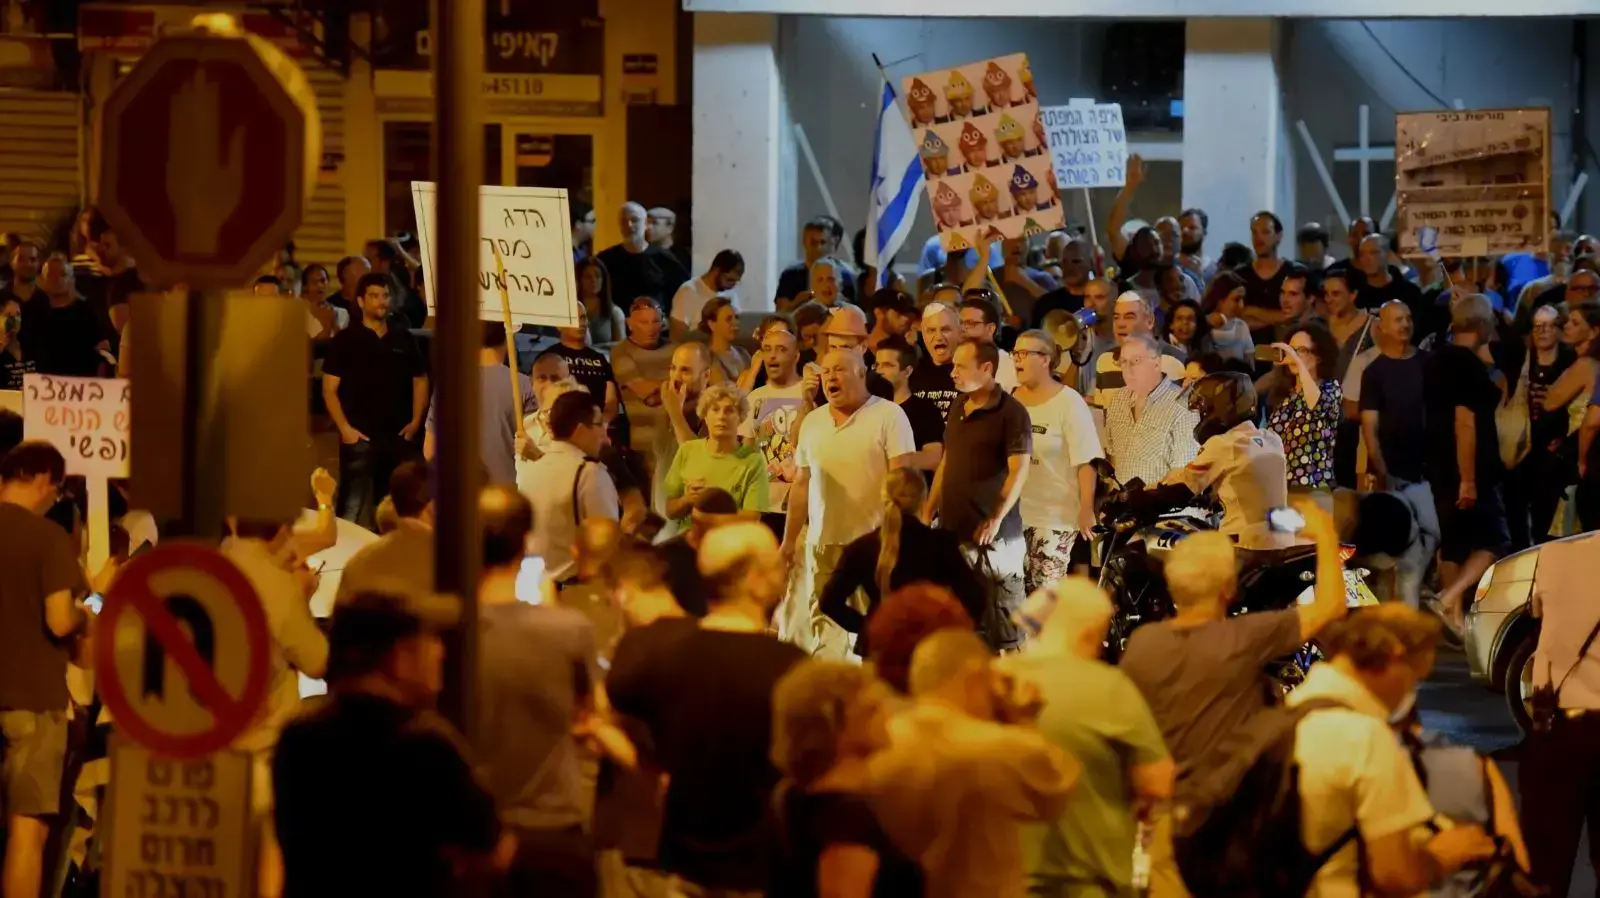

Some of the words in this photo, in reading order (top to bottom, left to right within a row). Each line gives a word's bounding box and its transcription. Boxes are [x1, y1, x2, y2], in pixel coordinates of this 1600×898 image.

[492, 31, 558, 67] קאיפי
[1088, 108, 1120, 125] איפה
[1436, 112, 1460, 122] ביבי
[1465, 111, 1504, 122] מורשת
[1050, 128, 1100, 147] הצוללת
[1102, 127, 1123, 143] של
[503, 208, 546, 229] הדג
[481, 237, 531, 259] מסר
[28, 376, 104, 402] במעצר
[45, 406, 101, 431] הנחש
[70, 435, 126, 461] ופשי
[139, 791, 220, 830] לרכב
[140, 834, 215, 868] חרום
